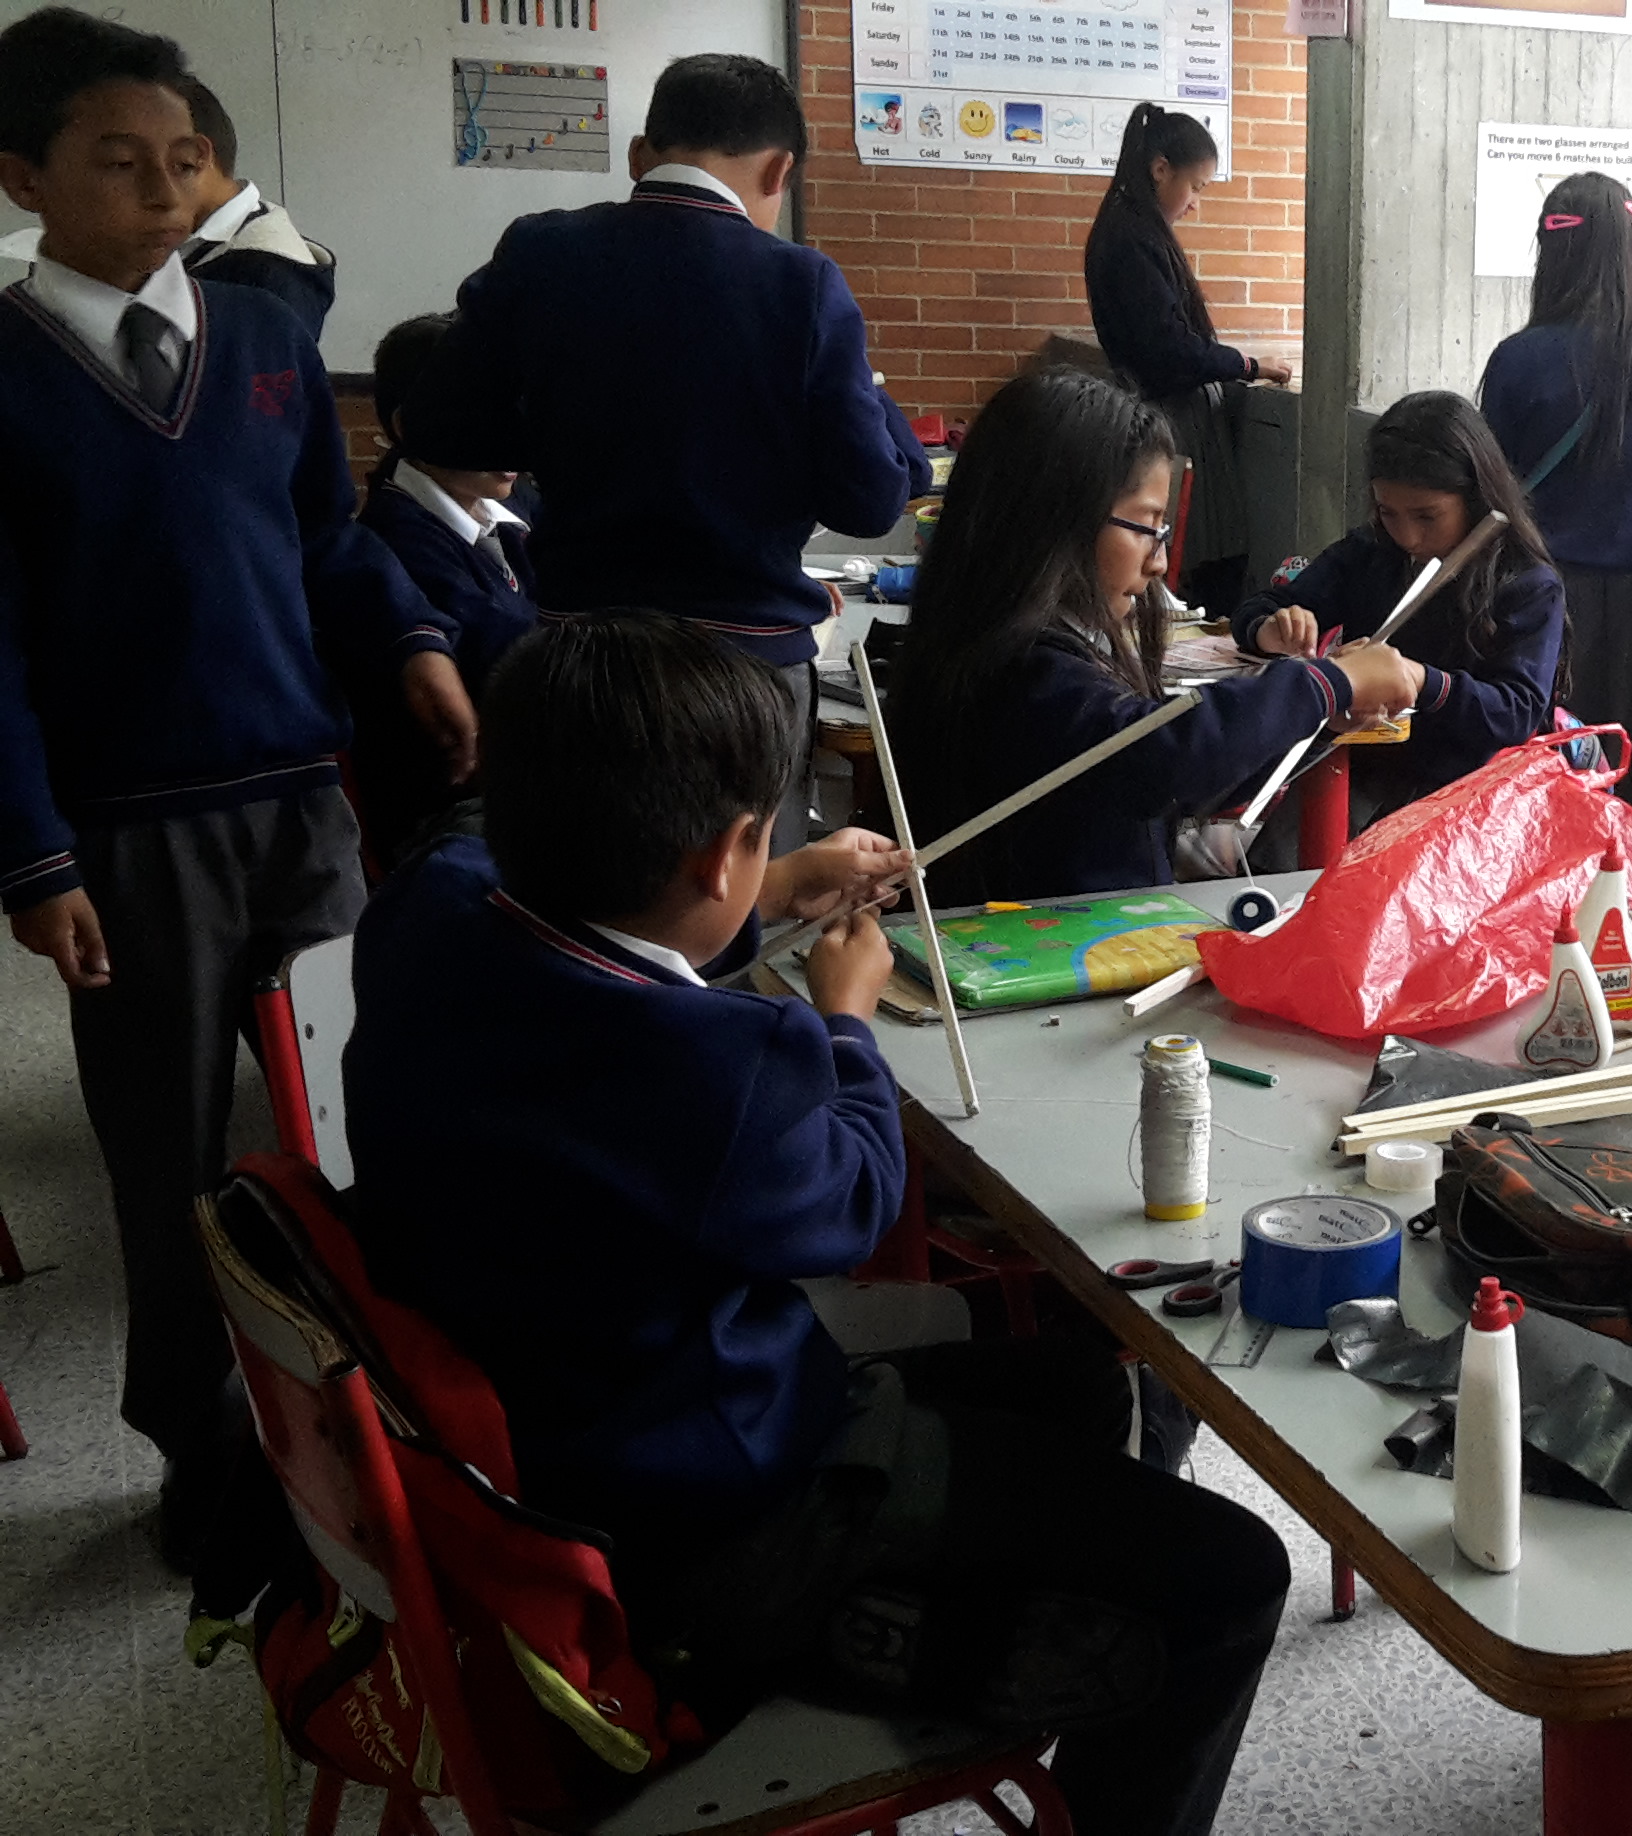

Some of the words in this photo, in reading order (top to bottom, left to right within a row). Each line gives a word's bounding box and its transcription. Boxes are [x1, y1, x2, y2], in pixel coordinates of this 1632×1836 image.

[871, 2, 895, 14] Friday
[867, 30, 900, 43] Saturday
[1488, 134, 1514, 144] There
[1517, 137, 1531, 145] are
[1535, 137, 1552, 146] two
[1555, 138, 1586, 149] glasses
[1589, 141, 1629, 151] arranged
[872, 147, 890, 156] Hot
[919, 149, 941, 159] Cold
[964, 151, 993, 164] Sunny
[1487, 149, 1504, 159] Can
[1508, 151, 1524, 161] you
[1527, 153, 1552, 162] move
[1555, 152, 1561, 161] 6
[1563, 154, 1600, 164] matches
[1603, 156, 1613, 164] to
[1012, 153, 1037, 165] Rainy
[1054, 154, 1085, 168] Cloudy
